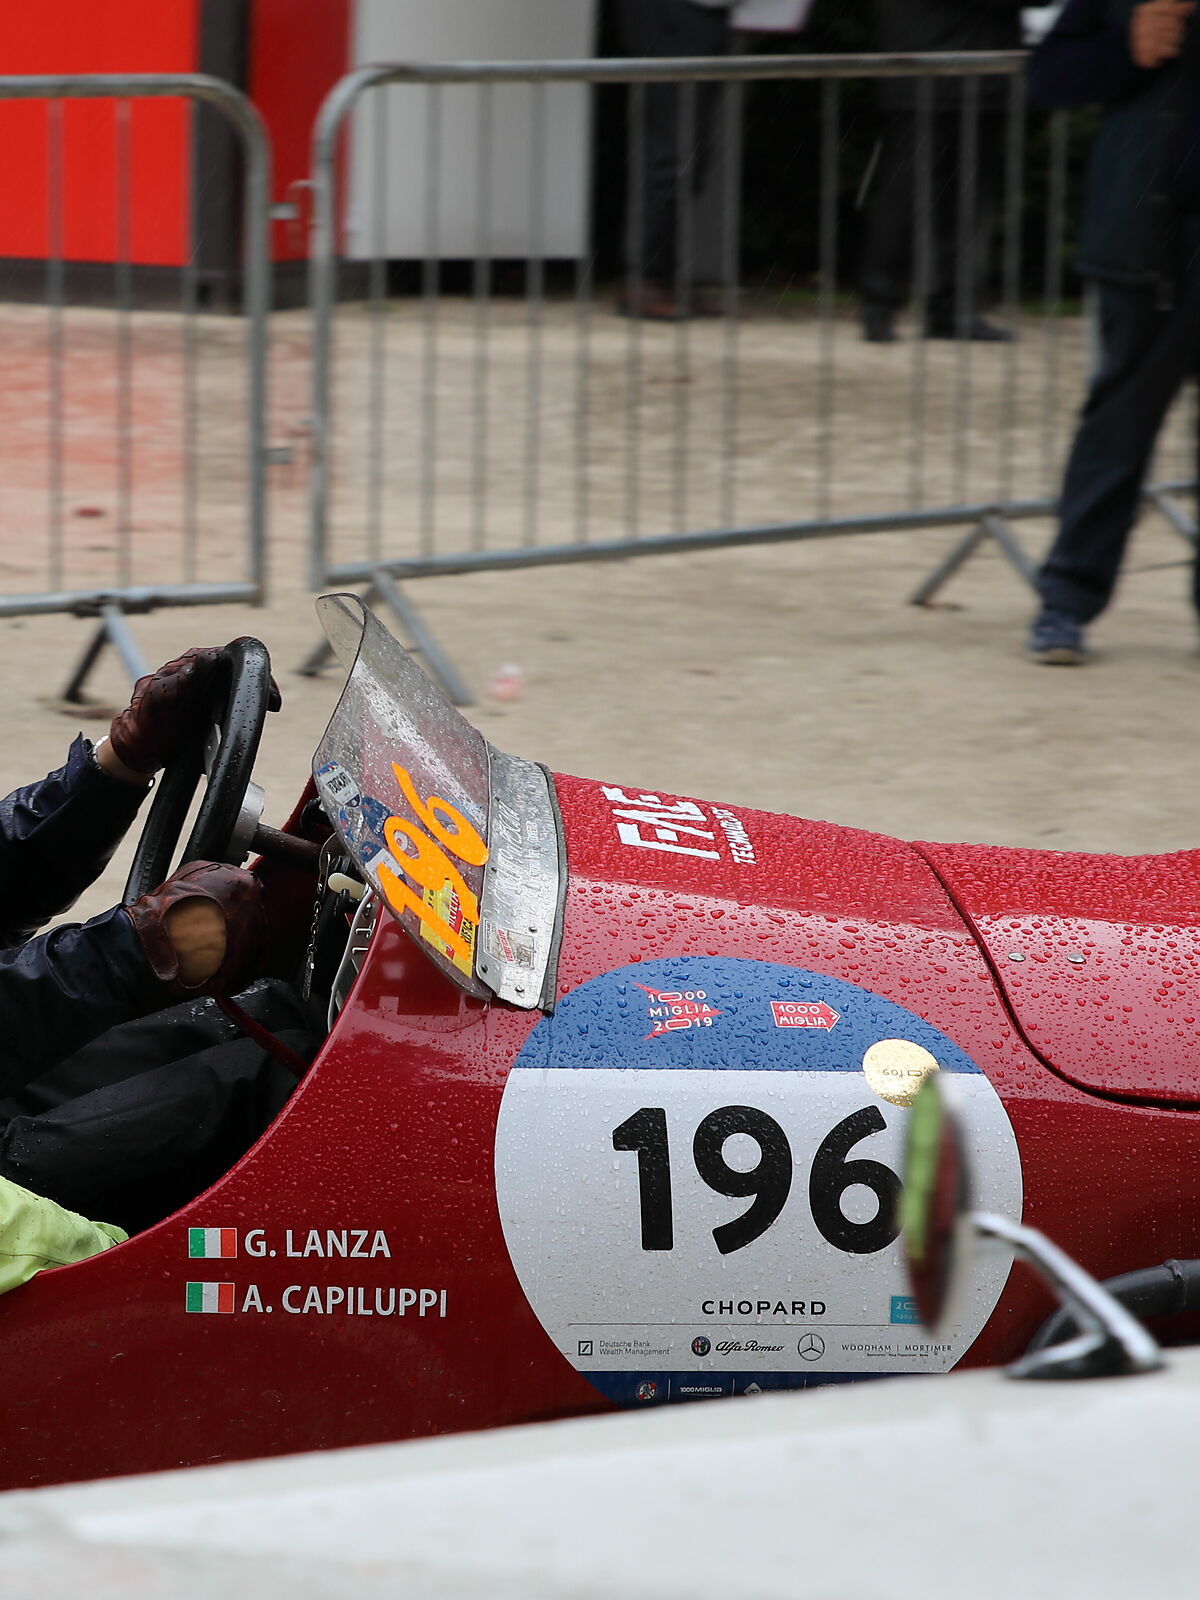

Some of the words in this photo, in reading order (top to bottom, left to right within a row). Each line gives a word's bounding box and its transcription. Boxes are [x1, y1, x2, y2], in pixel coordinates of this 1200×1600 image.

[377, 762, 489, 961] 196
[648, 990, 707, 1003] 1000
[649, 1003, 712, 1017] MIGLIA
[779, 1004, 820, 1014] 1000
[653, 1016, 713, 1032] 2019
[779, 1016, 827, 1026] MIGLIA
[612, 1105, 906, 1255] 196
[244, 1229, 277, 1258] G.
[286, 1229, 391, 1258] LANZA
[241, 1284, 273, 1314] A.
[281, 1285, 447, 1318] CAPILUPPI
[701, 1300, 826, 1315] CHOPARD
[600, 1340, 631, 1348] Deutsche
[633, 1340, 651, 1348] Bank
[715, 1341, 743, 1356] Alfa
[743, 1340, 785, 1352] Romeo
[904, 1344, 952, 1352] MORTIMER
[625, 1348, 670, 1356] Management
